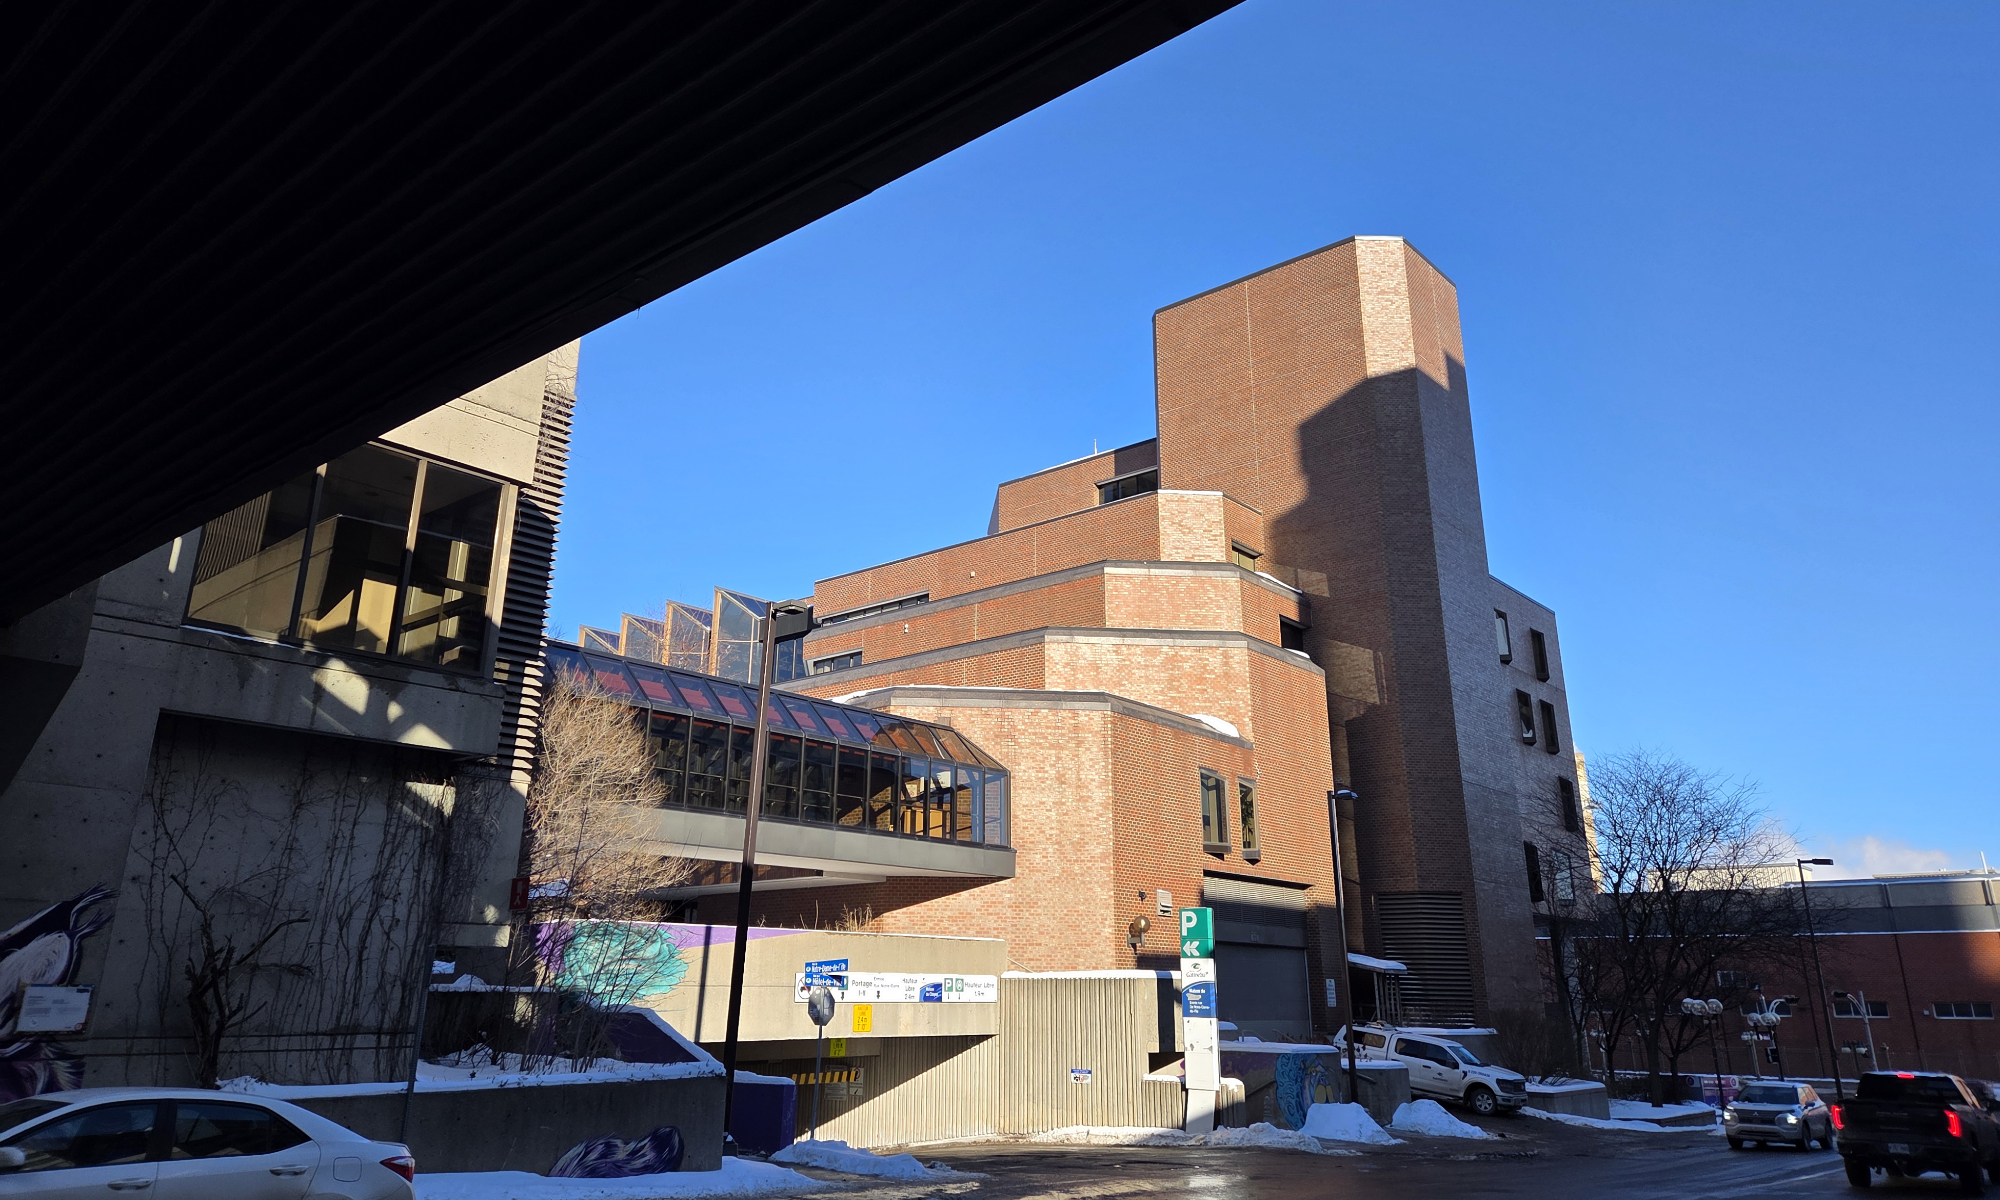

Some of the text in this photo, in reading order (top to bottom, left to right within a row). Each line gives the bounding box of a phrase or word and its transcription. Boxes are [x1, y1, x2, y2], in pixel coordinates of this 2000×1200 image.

[1181, 911, 1198, 936] P
[851, 980, 873, 989] Portage
[945, 979, 952, 991] P
